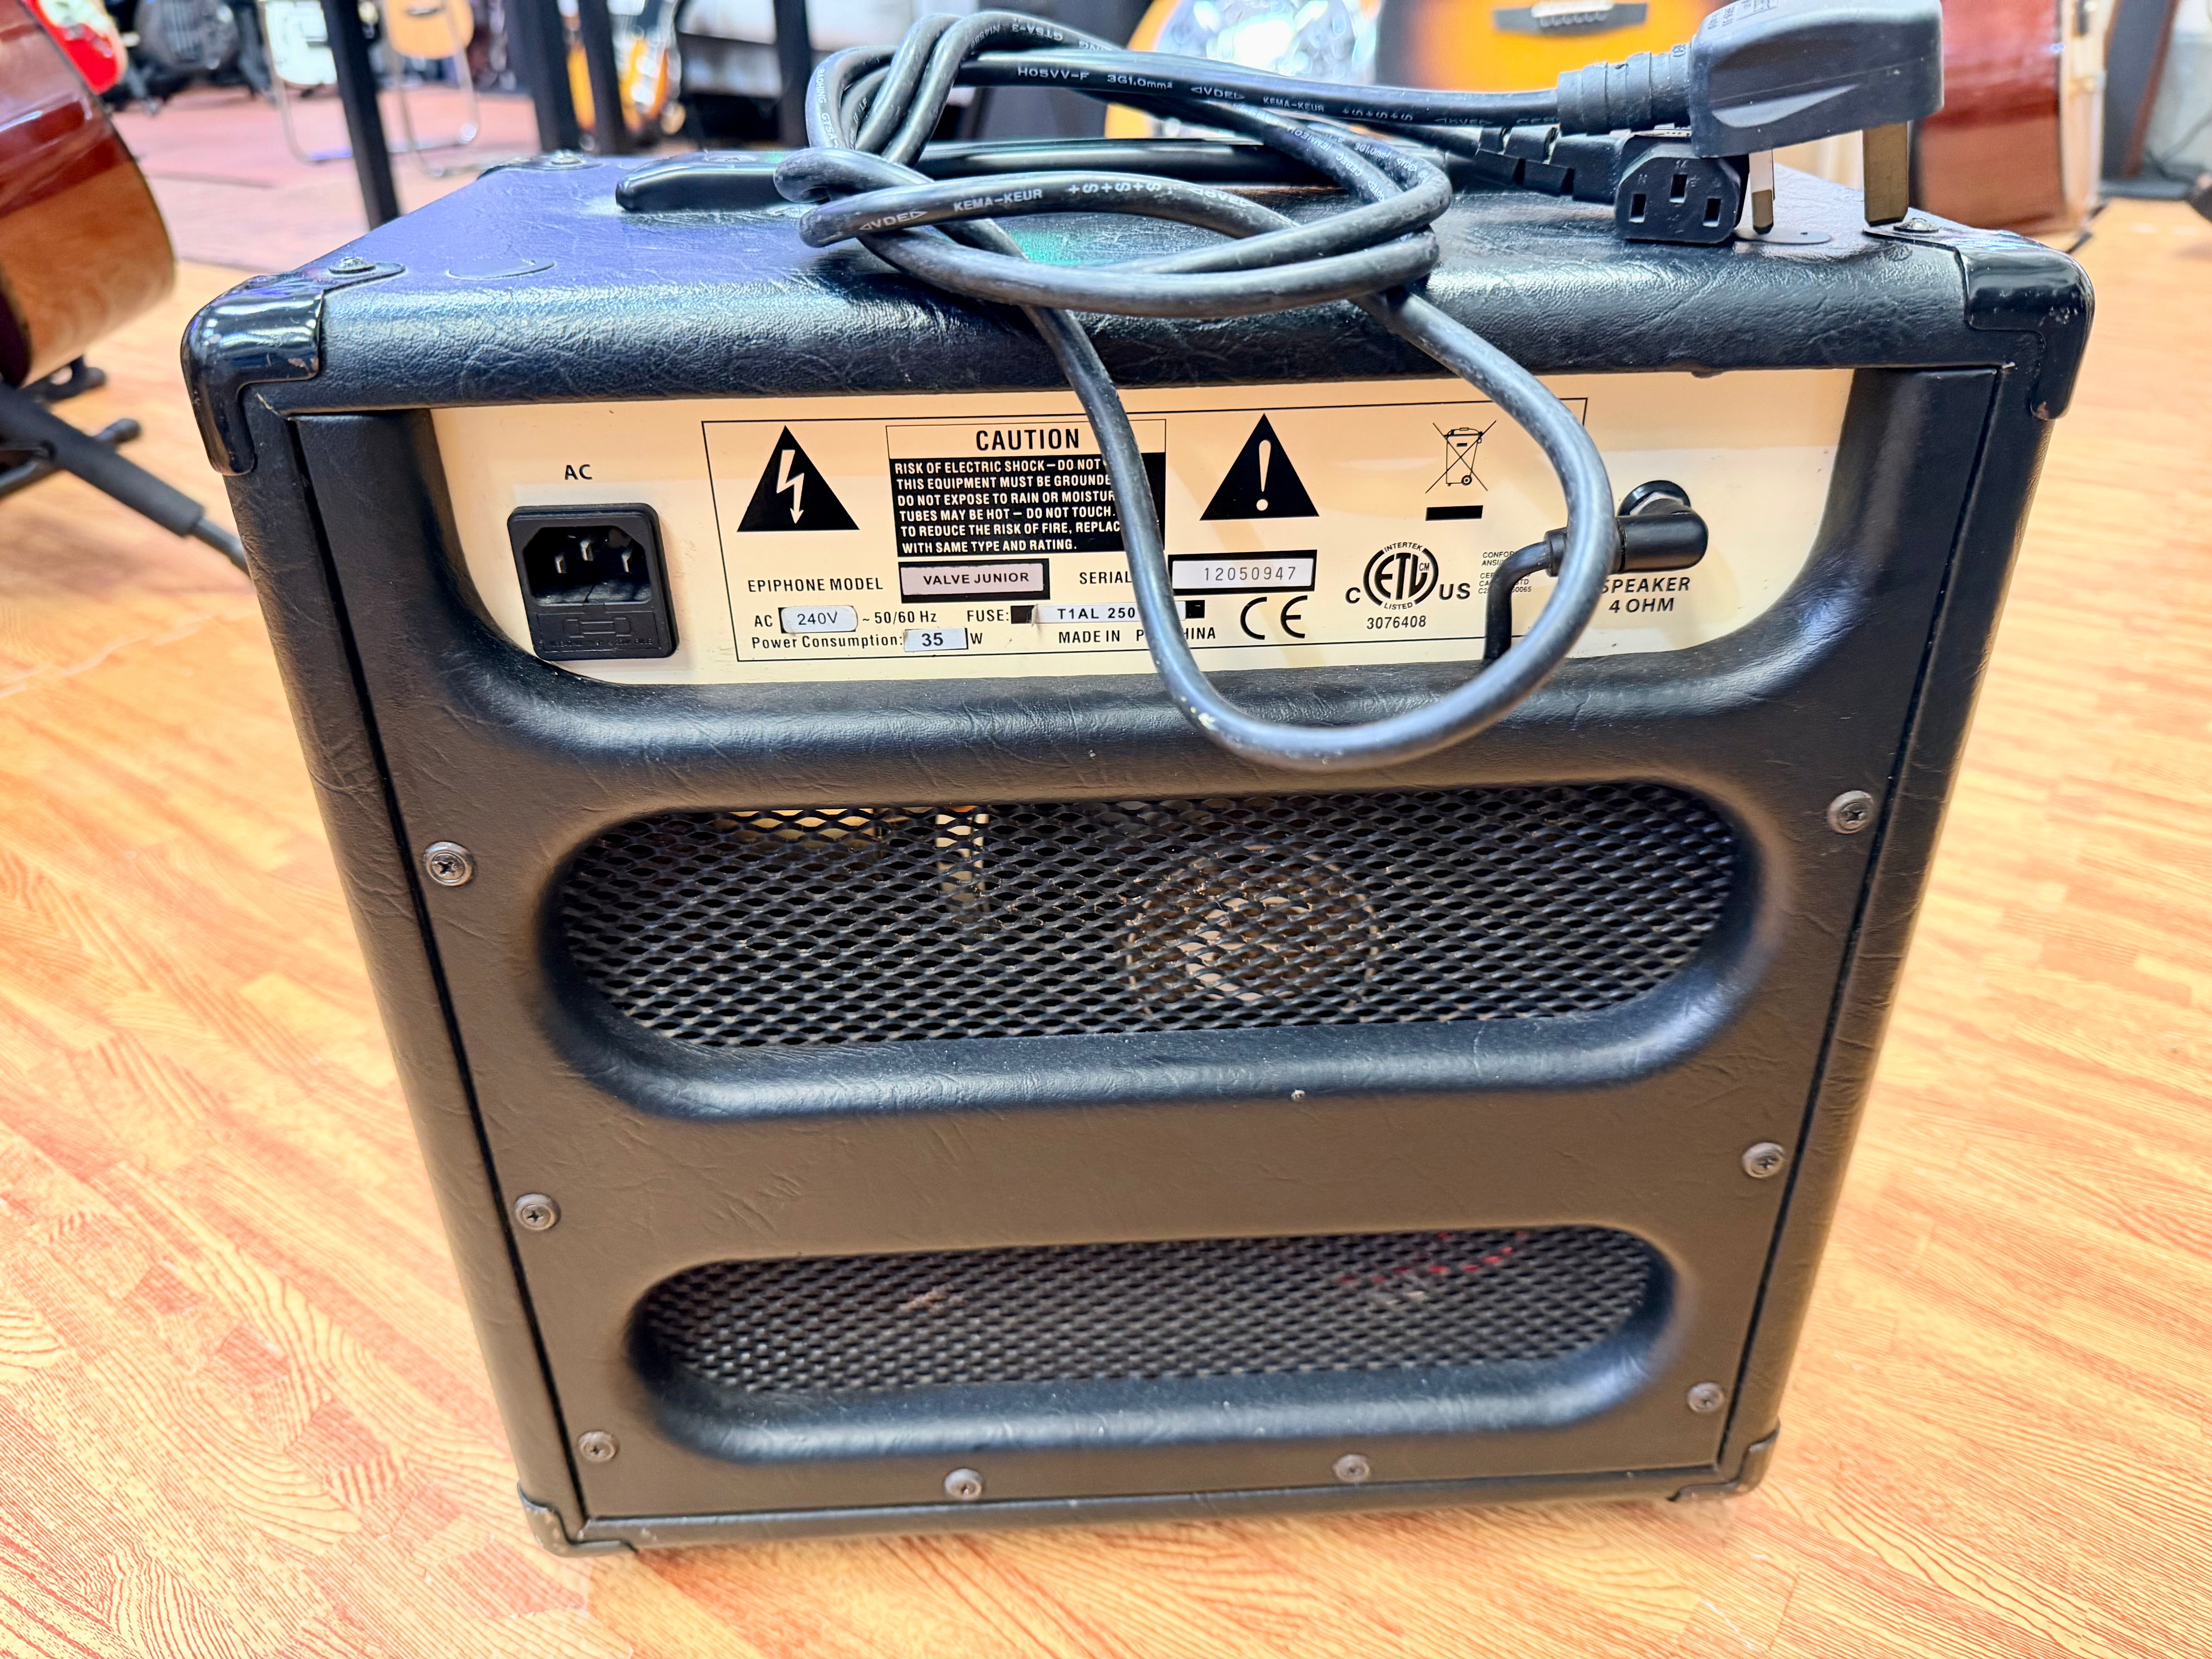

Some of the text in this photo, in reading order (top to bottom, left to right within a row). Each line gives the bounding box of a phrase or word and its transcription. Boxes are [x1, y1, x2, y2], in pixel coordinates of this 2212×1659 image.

[1263, 97, 1325, 113] KEMA-KEUR
[1336, 153, 1363, 176] CEBEC
[954, 189, 1043, 211] KEMA-KEUR
[976, 429, 1079, 450] CAUTION
[564, 464, 593, 481] AC
[895, 462, 924, 474] RISK
[926, 462, 941, 474] OF
[945, 461, 1002, 473] ELECTRIC
[1077, 459, 1101, 470] NOT
[896, 474, 1111, 490] THIS EQUIPMENT MUST BE GROUNDE
[897, 490, 1115, 506] DO NOT EXPOSE TO RAIN OR MOISTUR
[899, 510, 938, 522] TUBES
[940, 509, 966, 521] MAY
[969, 509, 984, 520] BE
[986, 508, 1010, 520] HOT
[1026, 507, 1042, 519] DO
[1046, 507, 1069, 518] NOT
[1072, 506, 1115, 517] TOUCH.
[900, 521, 1120, 537] TO REDUCE THE RISK OF FIRE, REPLAC
[902, 539, 1077, 554] WITH SAME TYPE AND RATING.
[1384, 542, 1423, 552] INTERTEK
[1205, 567, 1296, 581] 12050947
[1419, 562, 1430, 572] CM
[748, 577, 883, 592] EPIPHONE MODEL
[923, 572, 1030, 586] VALVE JUNIOR
[1079, 571, 1132, 585] SERIAL
[1374, 553, 1428, 600] ETL
[1439, 583, 1470, 600] US
[1384, 602, 1413, 610] LISTED
[1609, 598, 1674, 613] 4 OHM
[754, 615, 773, 627] AC
[797, 610, 838, 625] 240V
[875, 611, 915, 625] 50/60
[920, 611, 937, 623] Hz
[967, 607, 1135, 622] FUSE: T1AL 250
[1240, 595, 1308, 640] CE
[1366, 615, 1426, 629] 3076408
[752, 632, 983, 649] Power Consumption: 35 W
[1059, 631, 1101, 643] MADE
[1106, 630, 1120, 642] IN
[1183, 627, 1216, 640] HINA
